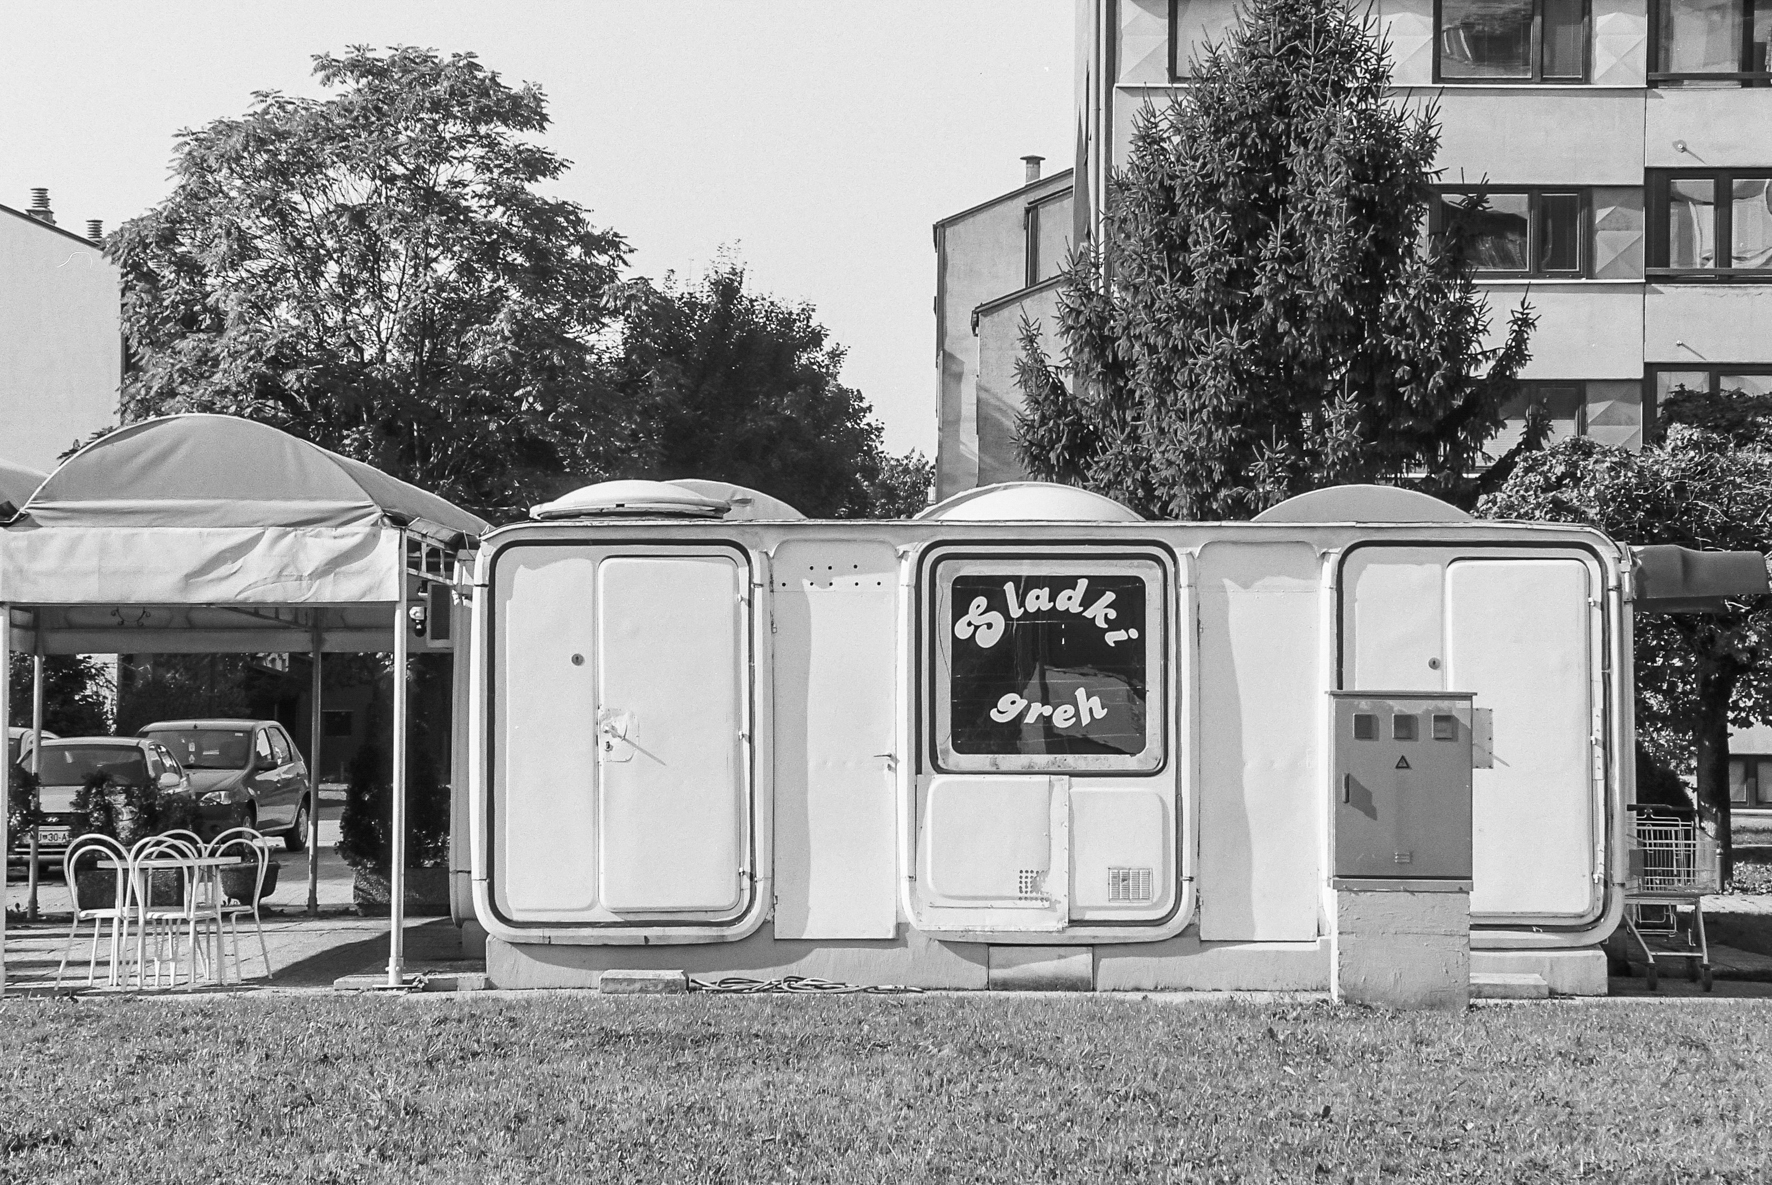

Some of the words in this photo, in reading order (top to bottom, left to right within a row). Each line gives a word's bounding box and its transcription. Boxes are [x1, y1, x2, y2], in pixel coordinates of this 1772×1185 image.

[954, 578, 1139, 649] Sladki
[989, 686, 1108, 728] greh
[47, 832, 68, 842] 30-A
